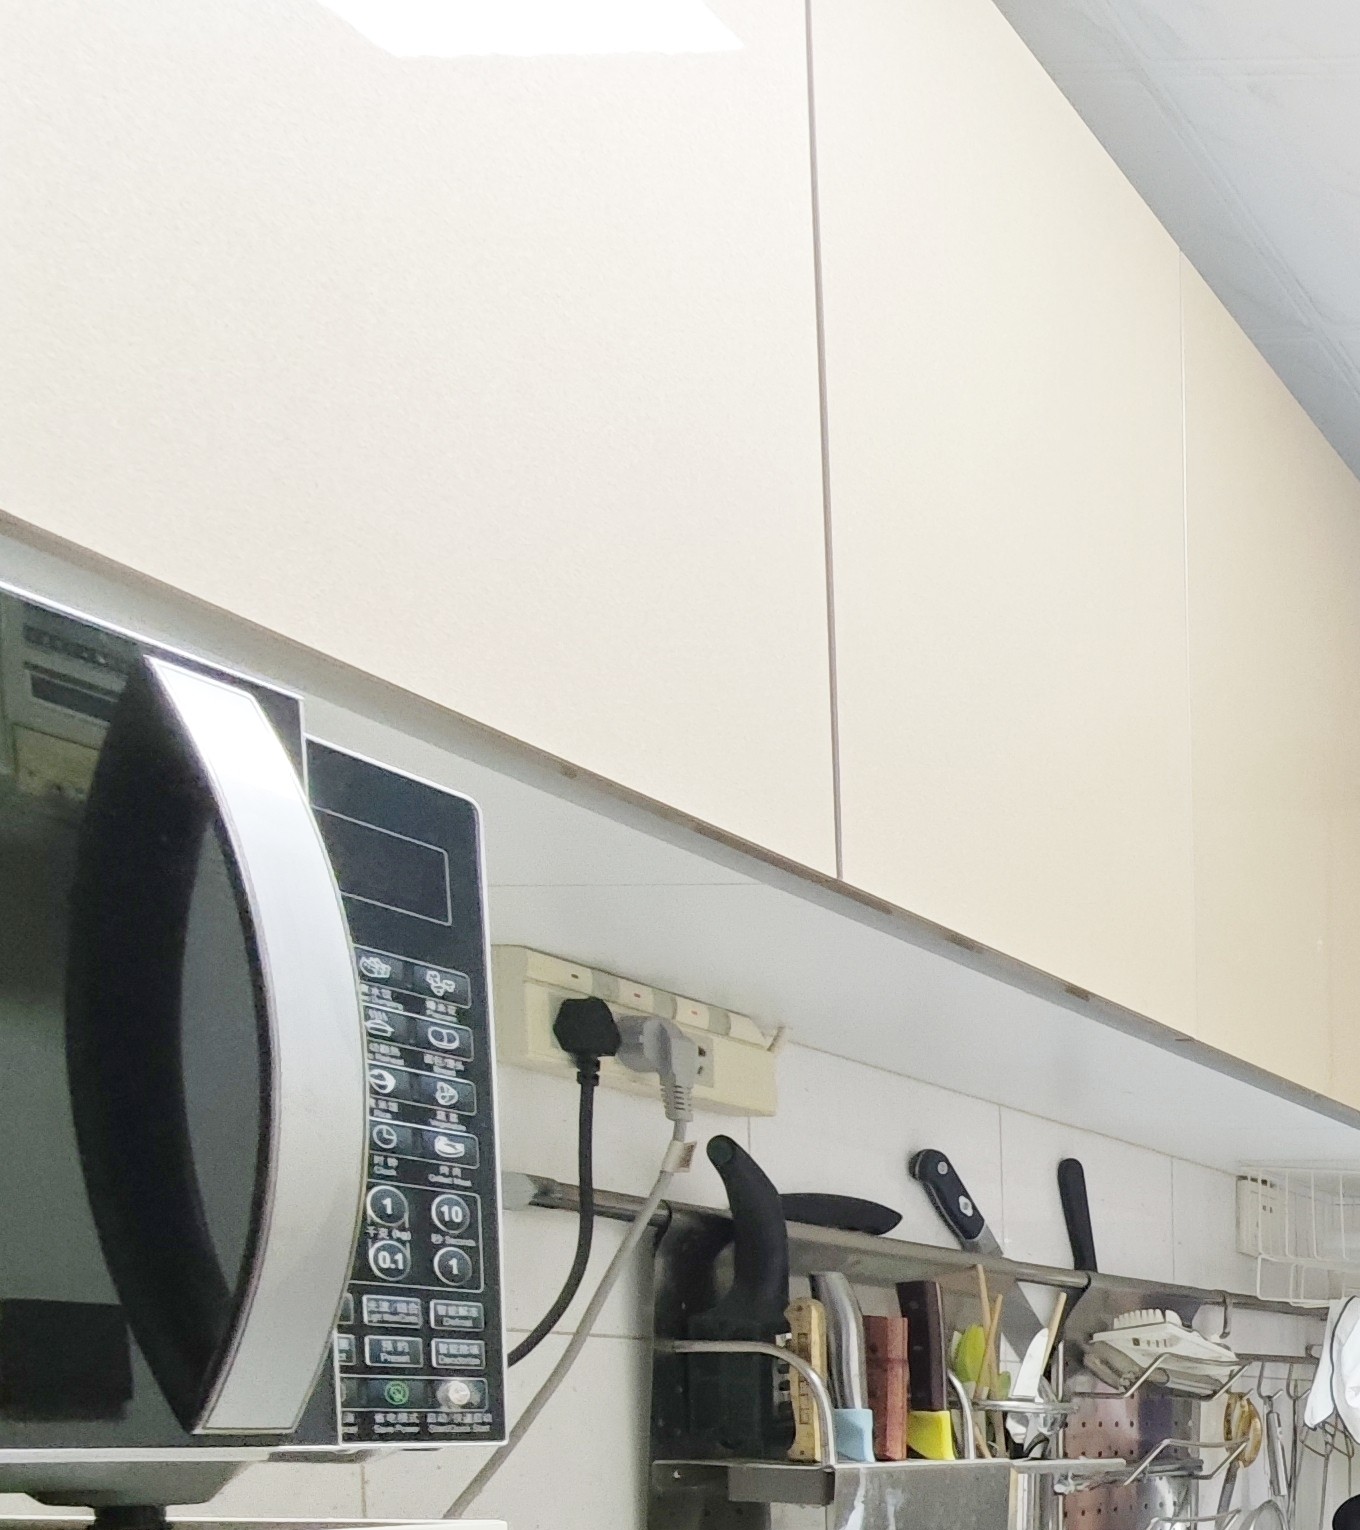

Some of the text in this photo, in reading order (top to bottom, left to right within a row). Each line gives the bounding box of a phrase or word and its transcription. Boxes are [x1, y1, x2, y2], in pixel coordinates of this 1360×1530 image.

[382, 1197, 393, 1215] 1
[440, 1204, 463, 1222] 10
[377, 1250, 404, 1270] 0.1
[448, 1257, 459, 1275] 1
